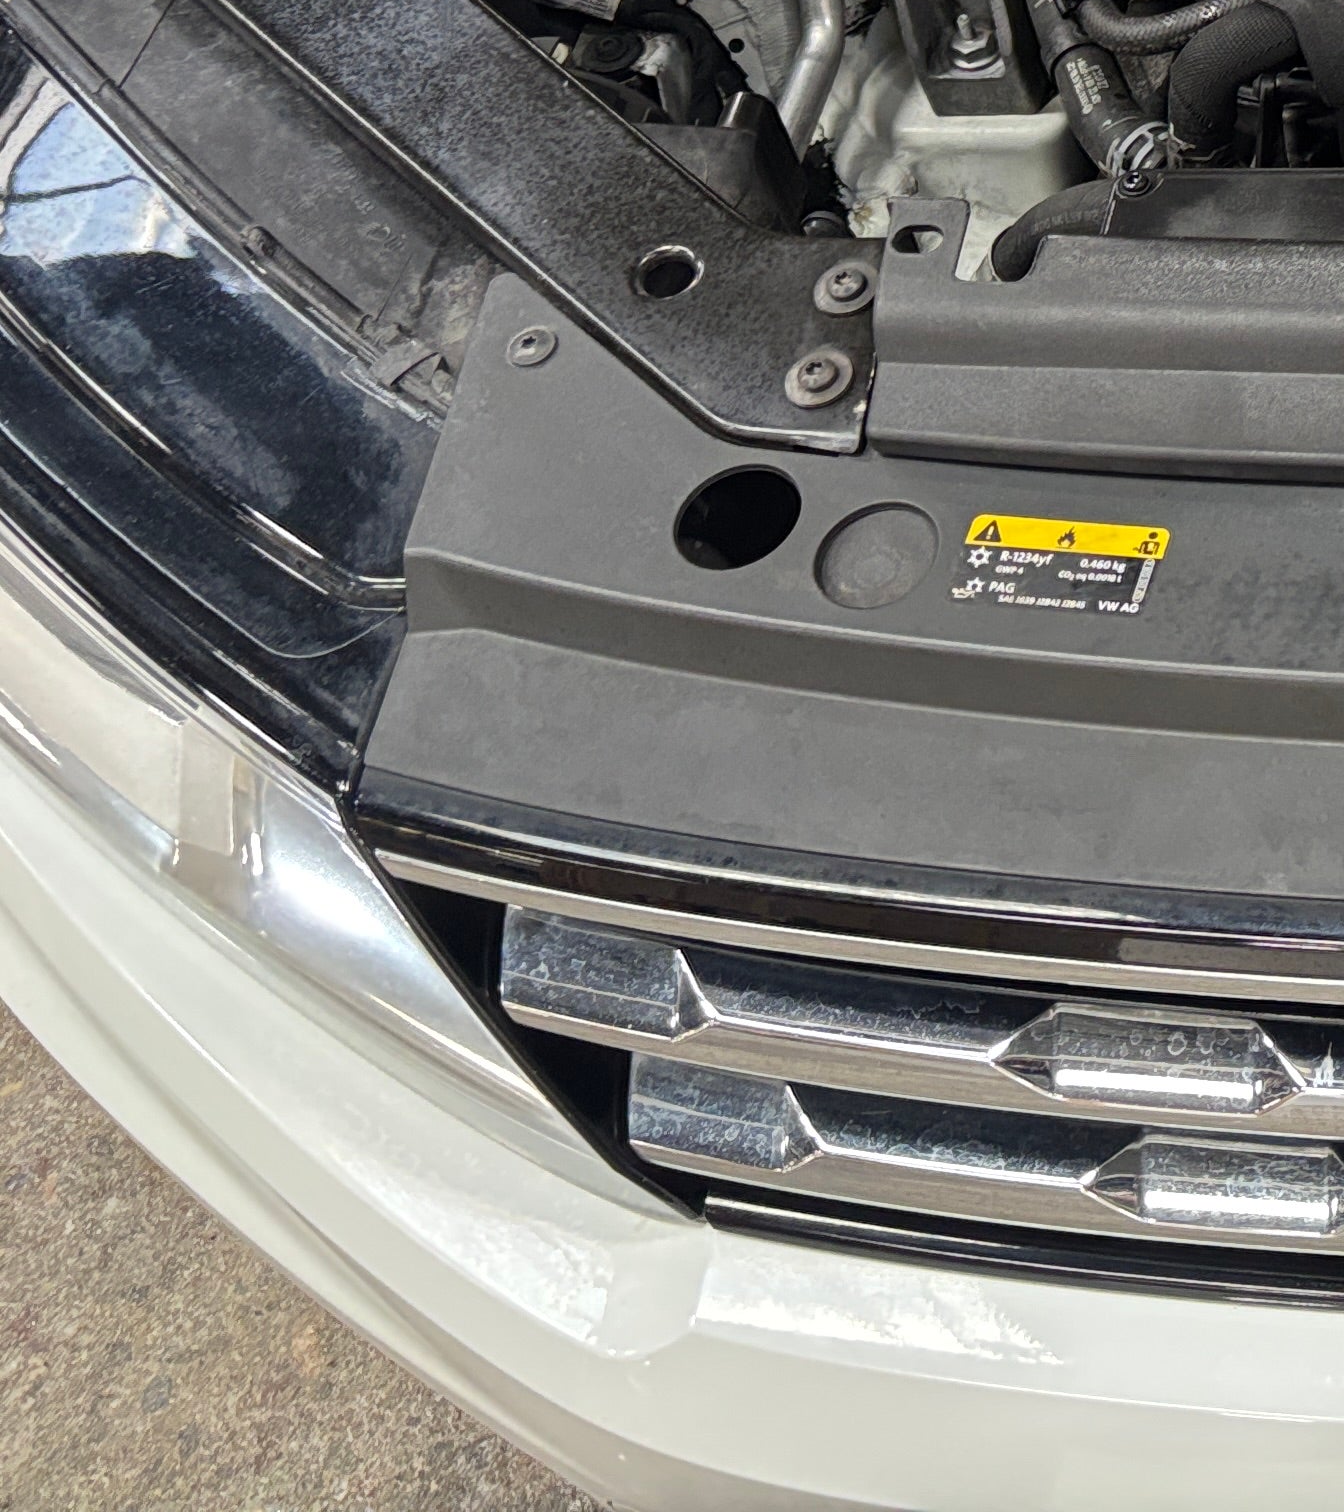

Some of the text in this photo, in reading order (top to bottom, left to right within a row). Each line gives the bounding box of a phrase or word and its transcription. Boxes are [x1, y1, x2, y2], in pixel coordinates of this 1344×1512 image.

[999, 550, 1126, 573] R-1234yf 0.460 kg
[995, 565, 1024, 575] GWP 4
[988, 581, 1016, 593] PAG
[1098, 600, 1140, 613] VW AG
